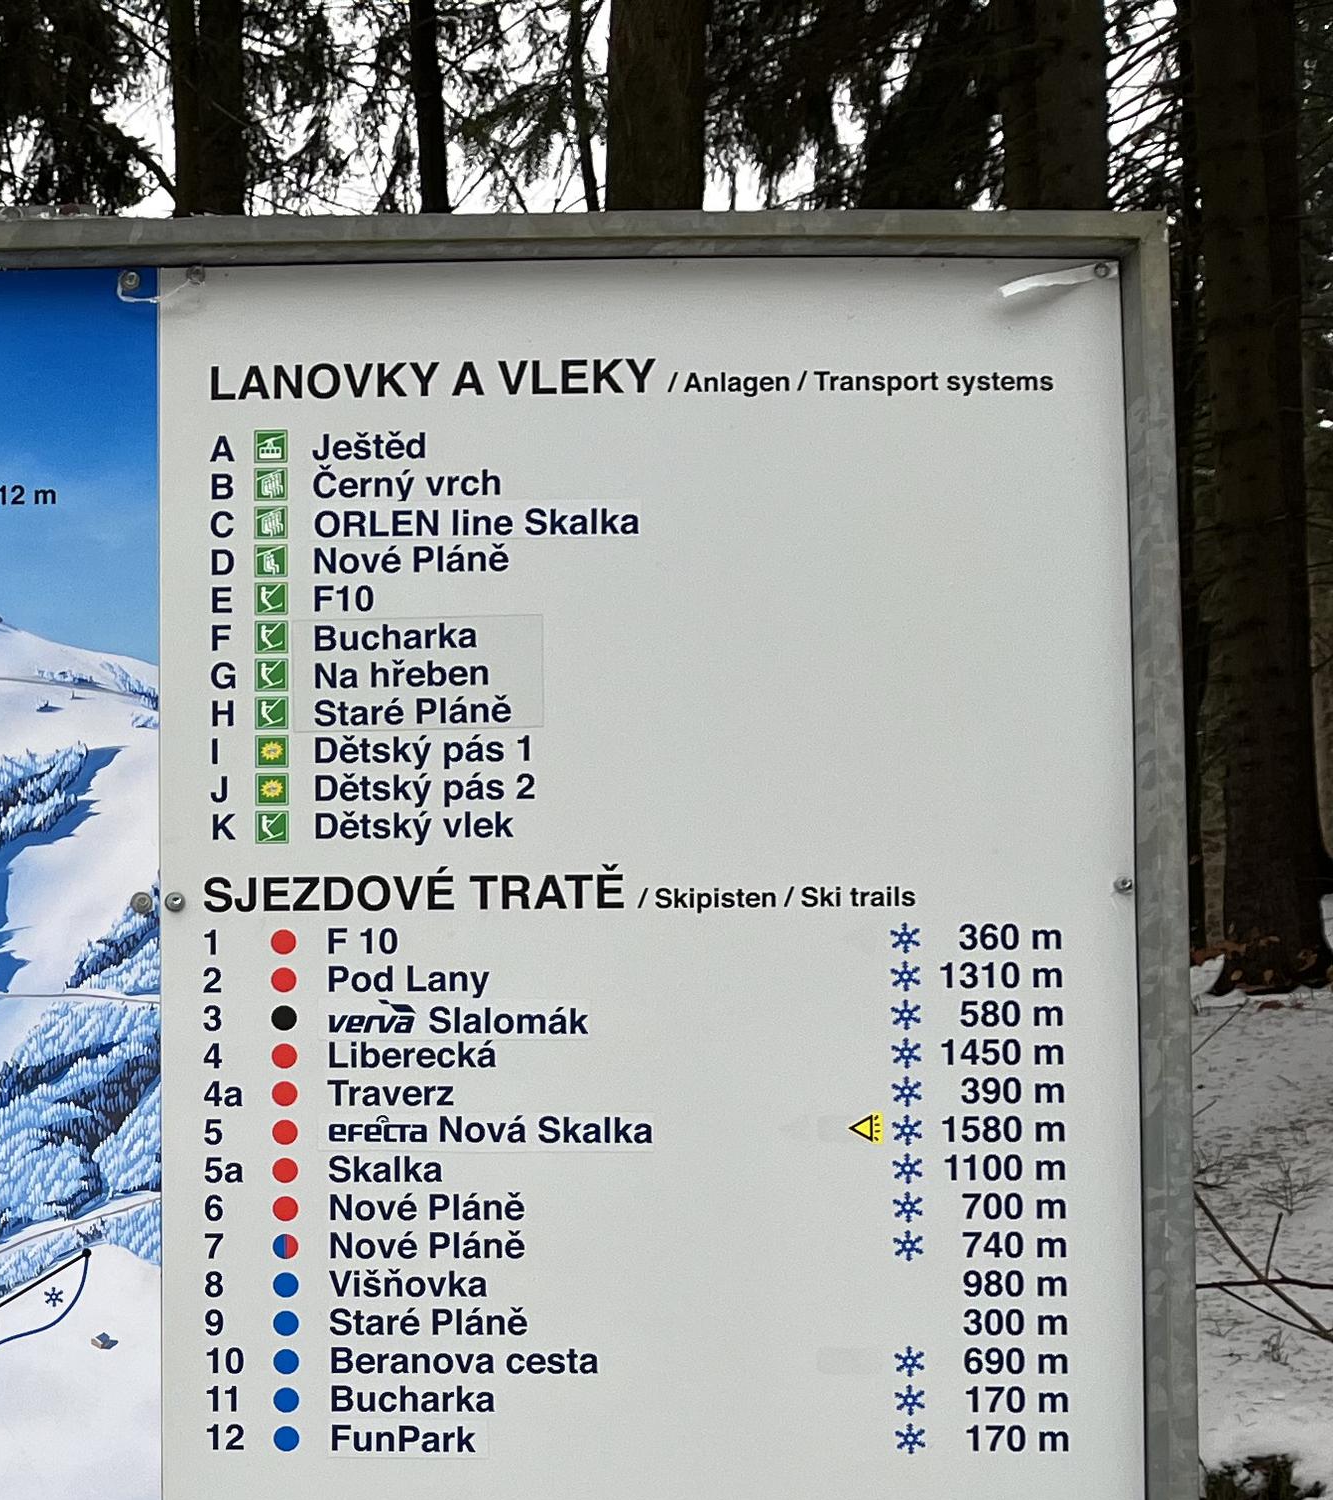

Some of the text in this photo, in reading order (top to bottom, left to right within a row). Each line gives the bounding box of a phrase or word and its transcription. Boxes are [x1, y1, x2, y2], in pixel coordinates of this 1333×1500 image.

[210, 357, 1054, 401] LANOVKY A VLEKY Anlagen Transport systems
[311, 430, 426, 461] Ještěd
[34, 488, 57, 505] m
[312, 464, 501, 503] Černý vrch
[314, 507, 640, 539] ORLEN line Skalka
[313, 542, 510, 575] Nové Pláně
[313, 584, 374, 613] F10
[314, 622, 478, 652] Bucharka
[314, 658, 489, 690] Na hřeben
[314, 694, 512, 727] Staré Pláně
[203, 863, 916, 914] SJEZDOVÉ TRATĚ Skipisten Ski trails
[327, 927, 398, 955] F 10
[328, 964, 490, 999] Pod Lany
[428, 1005, 589, 1035] Slalomák
[328, 1039, 497, 1069] Liberecká
[326, 1079, 455, 1107] Traverz
[439, 1114, 527, 1144] Nová
[537, 1115, 653, 1145] Skalka
[328, 1154, 443, 1184] Skalka
[329, 1191, 525, 1222] Nové Pláně
[329, 1229, 526, 1260] Nové Pláně
[328, 1268, 488, 1298] Višňovka
[329, 1306, 528, 1337] Staré Pláně
[330, 1346, 599, 1375] Beranova cesta
[330, 1384, 496, 1413] Bucharka
[331, 1423, 477, 1453] FunPark
